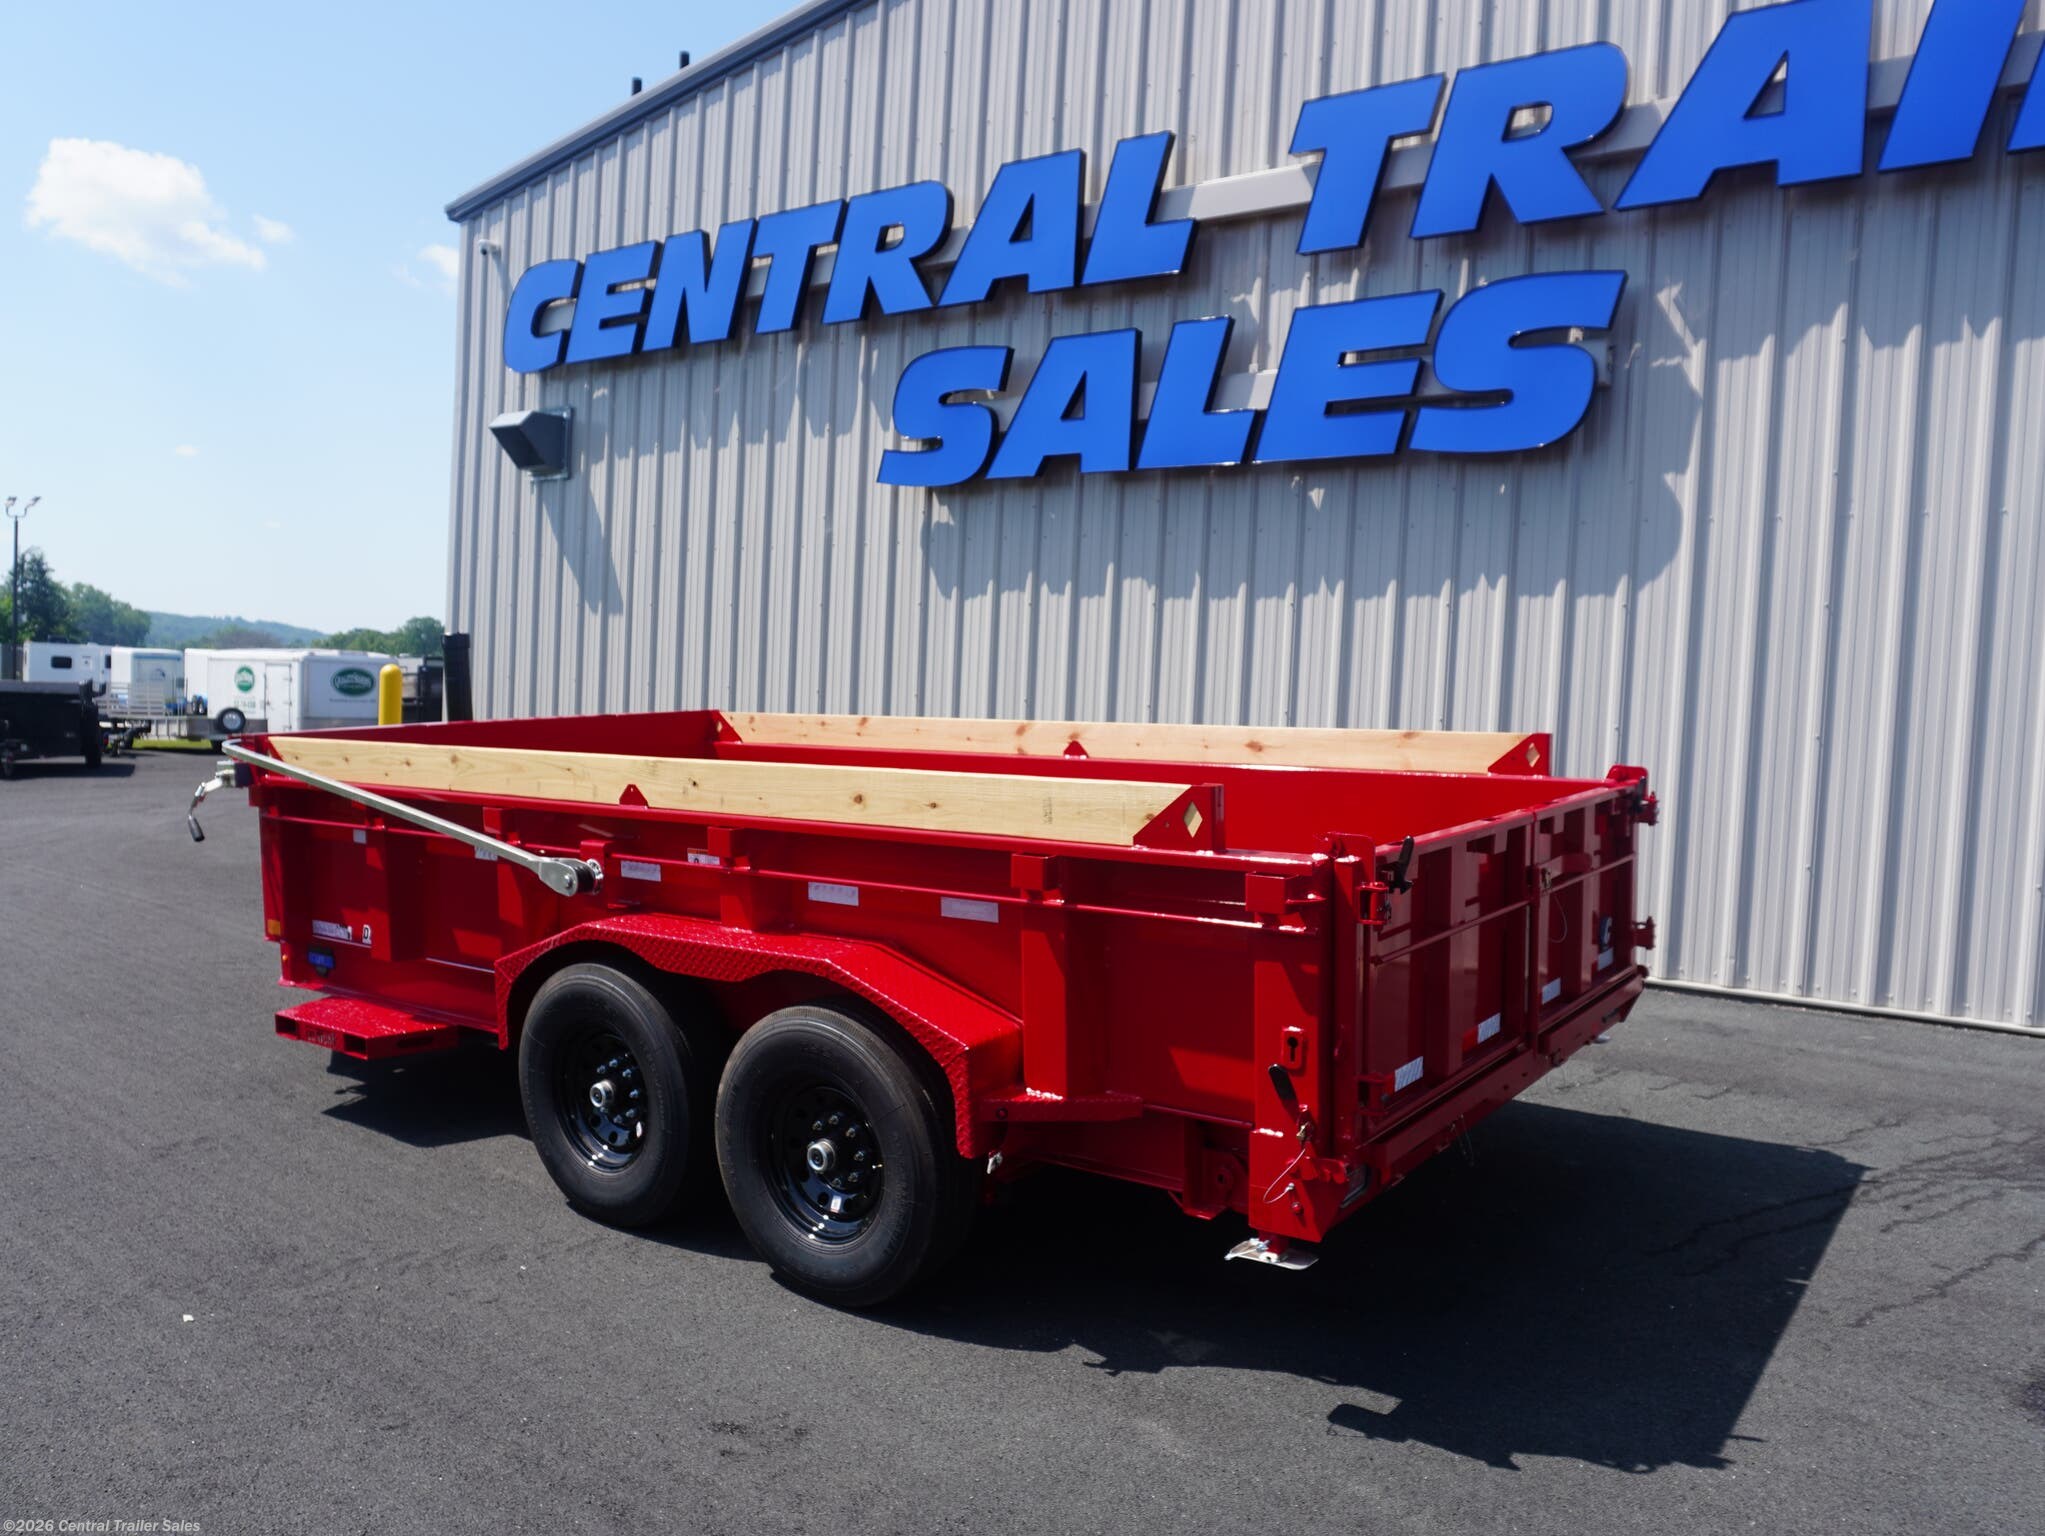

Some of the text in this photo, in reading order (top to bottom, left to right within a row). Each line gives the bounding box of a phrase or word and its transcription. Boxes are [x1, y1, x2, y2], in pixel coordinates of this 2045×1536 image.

[503, 0, 2045, 374] CENTRAL TRAI
[877, 270, 1628, 487] SALES
